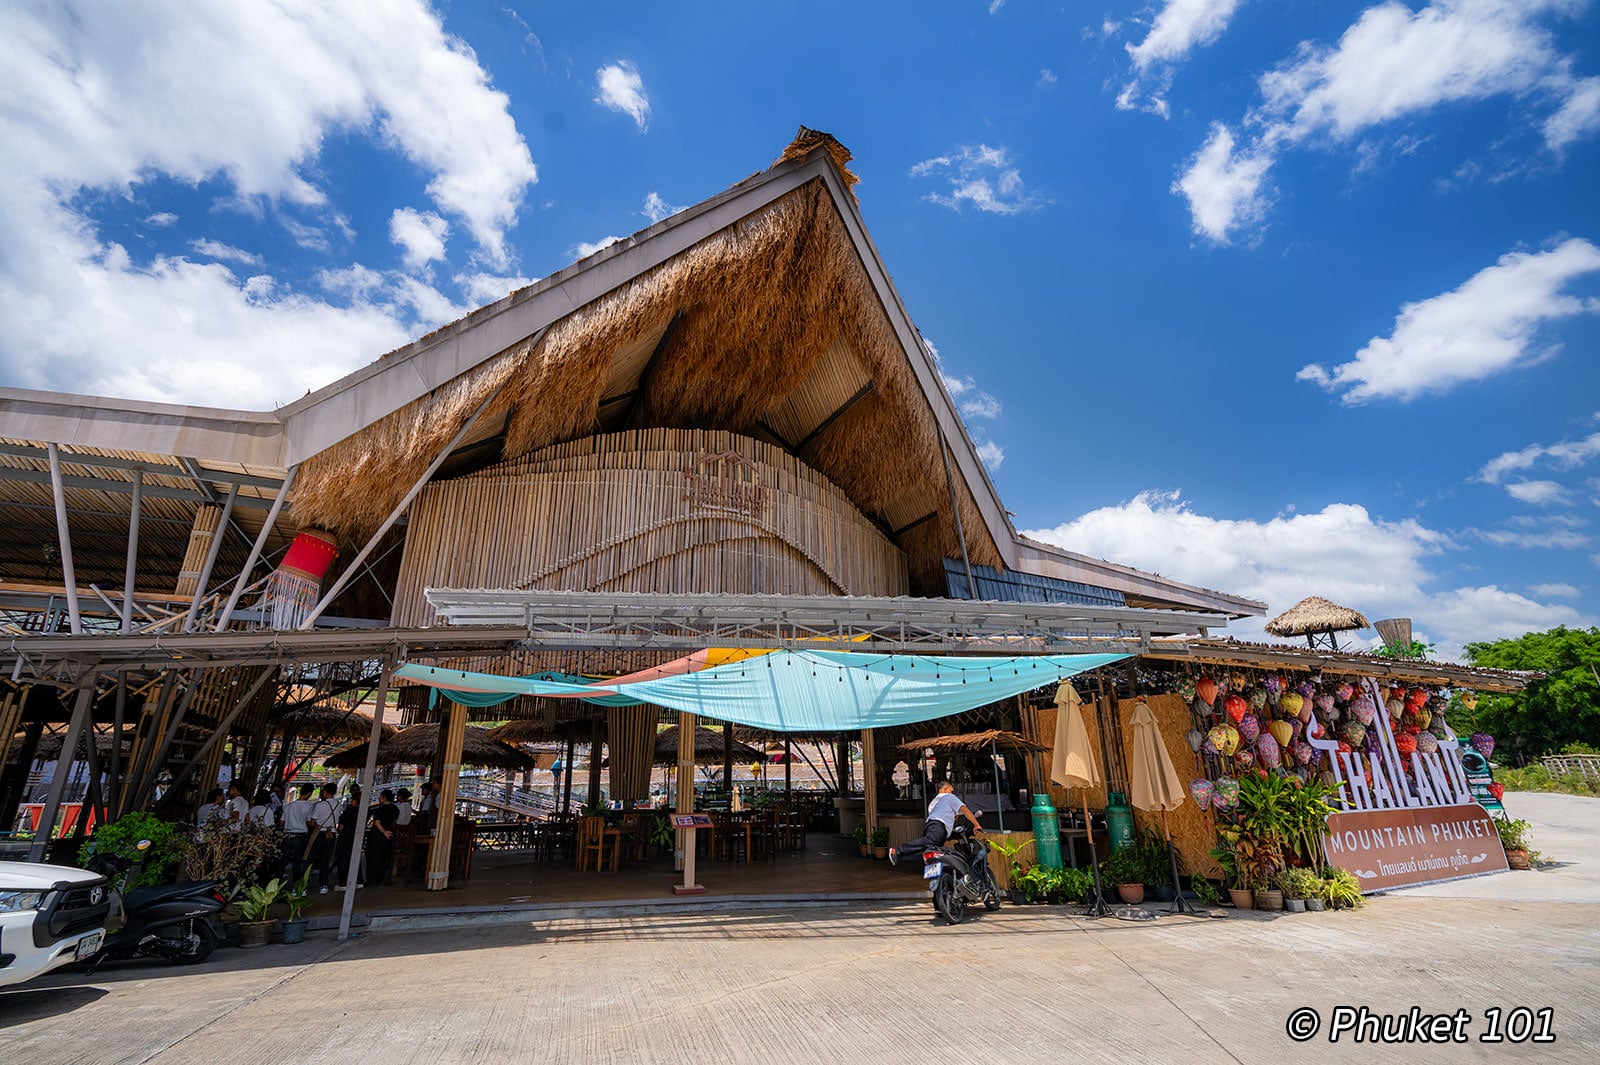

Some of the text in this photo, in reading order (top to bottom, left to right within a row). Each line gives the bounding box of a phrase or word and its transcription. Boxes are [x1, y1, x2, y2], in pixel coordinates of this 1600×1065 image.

[1307, 678, 1470, 810] THAILAND
[1330, 819, 1492, 854] MOUNTAIN PHUKET
[1377, 849, 1469, 876] ไทยแลนด์ เมาน์เทน ภูเก็ต
